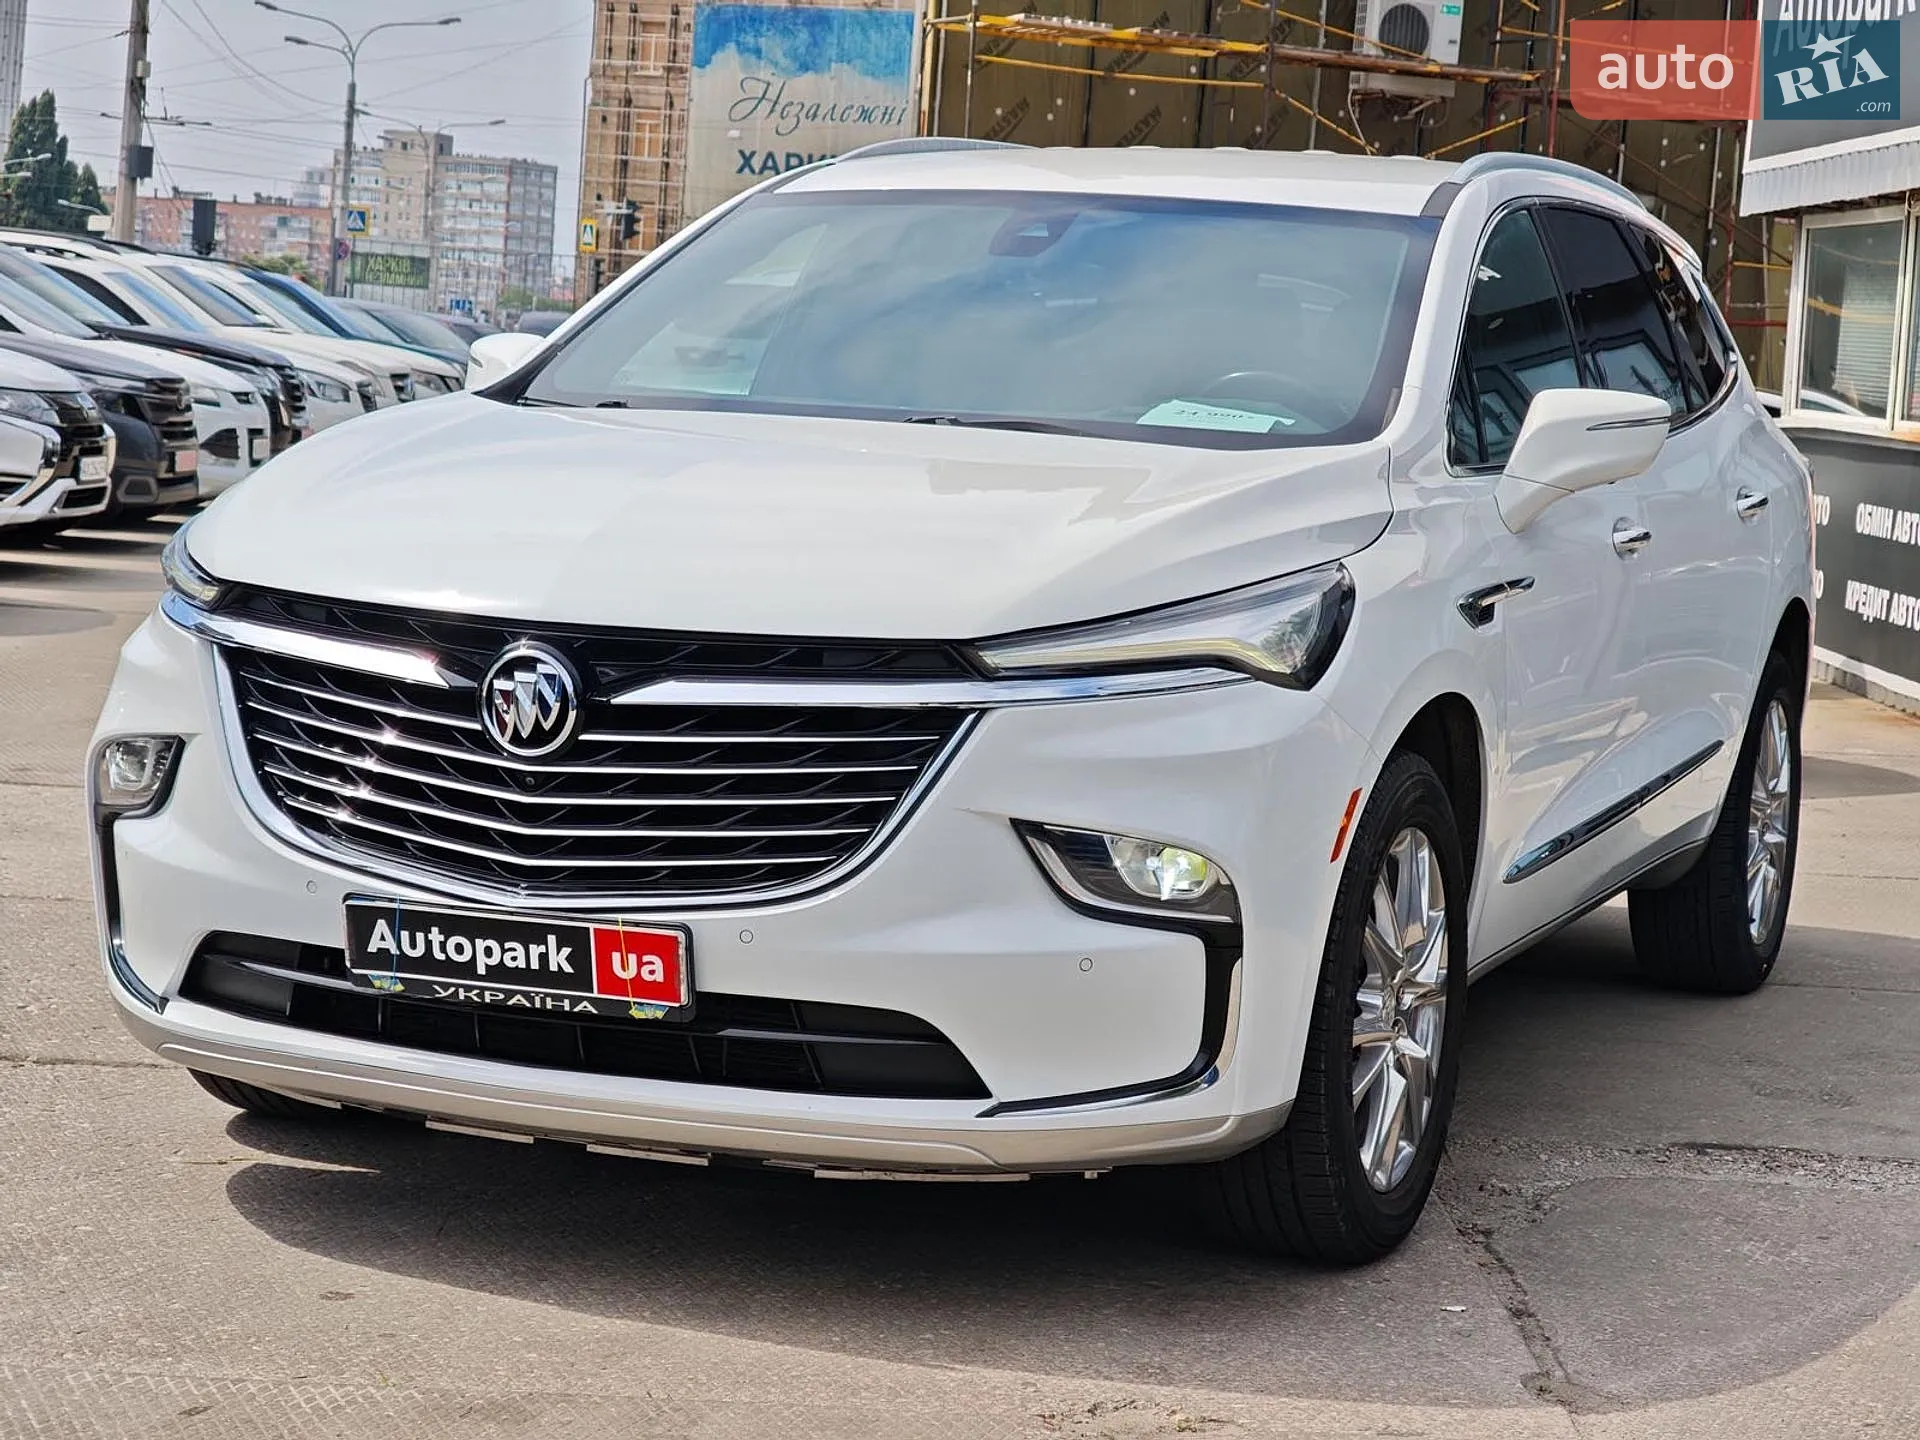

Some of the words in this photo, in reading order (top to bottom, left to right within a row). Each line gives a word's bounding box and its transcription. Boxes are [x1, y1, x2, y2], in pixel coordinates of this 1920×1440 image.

[728, 76, 909, 136] Незалежні
[735, 148, 838, 176] ХАР
[1855, 502, 1893, 540] ОБМІН
[1845, 579, 1890, 623] КРЕДИТ
[367, 918, 575, 976] Autopark
[611, 949, 665, 983] ua
[432, 984, 599, 1014] УКРАЇНА
